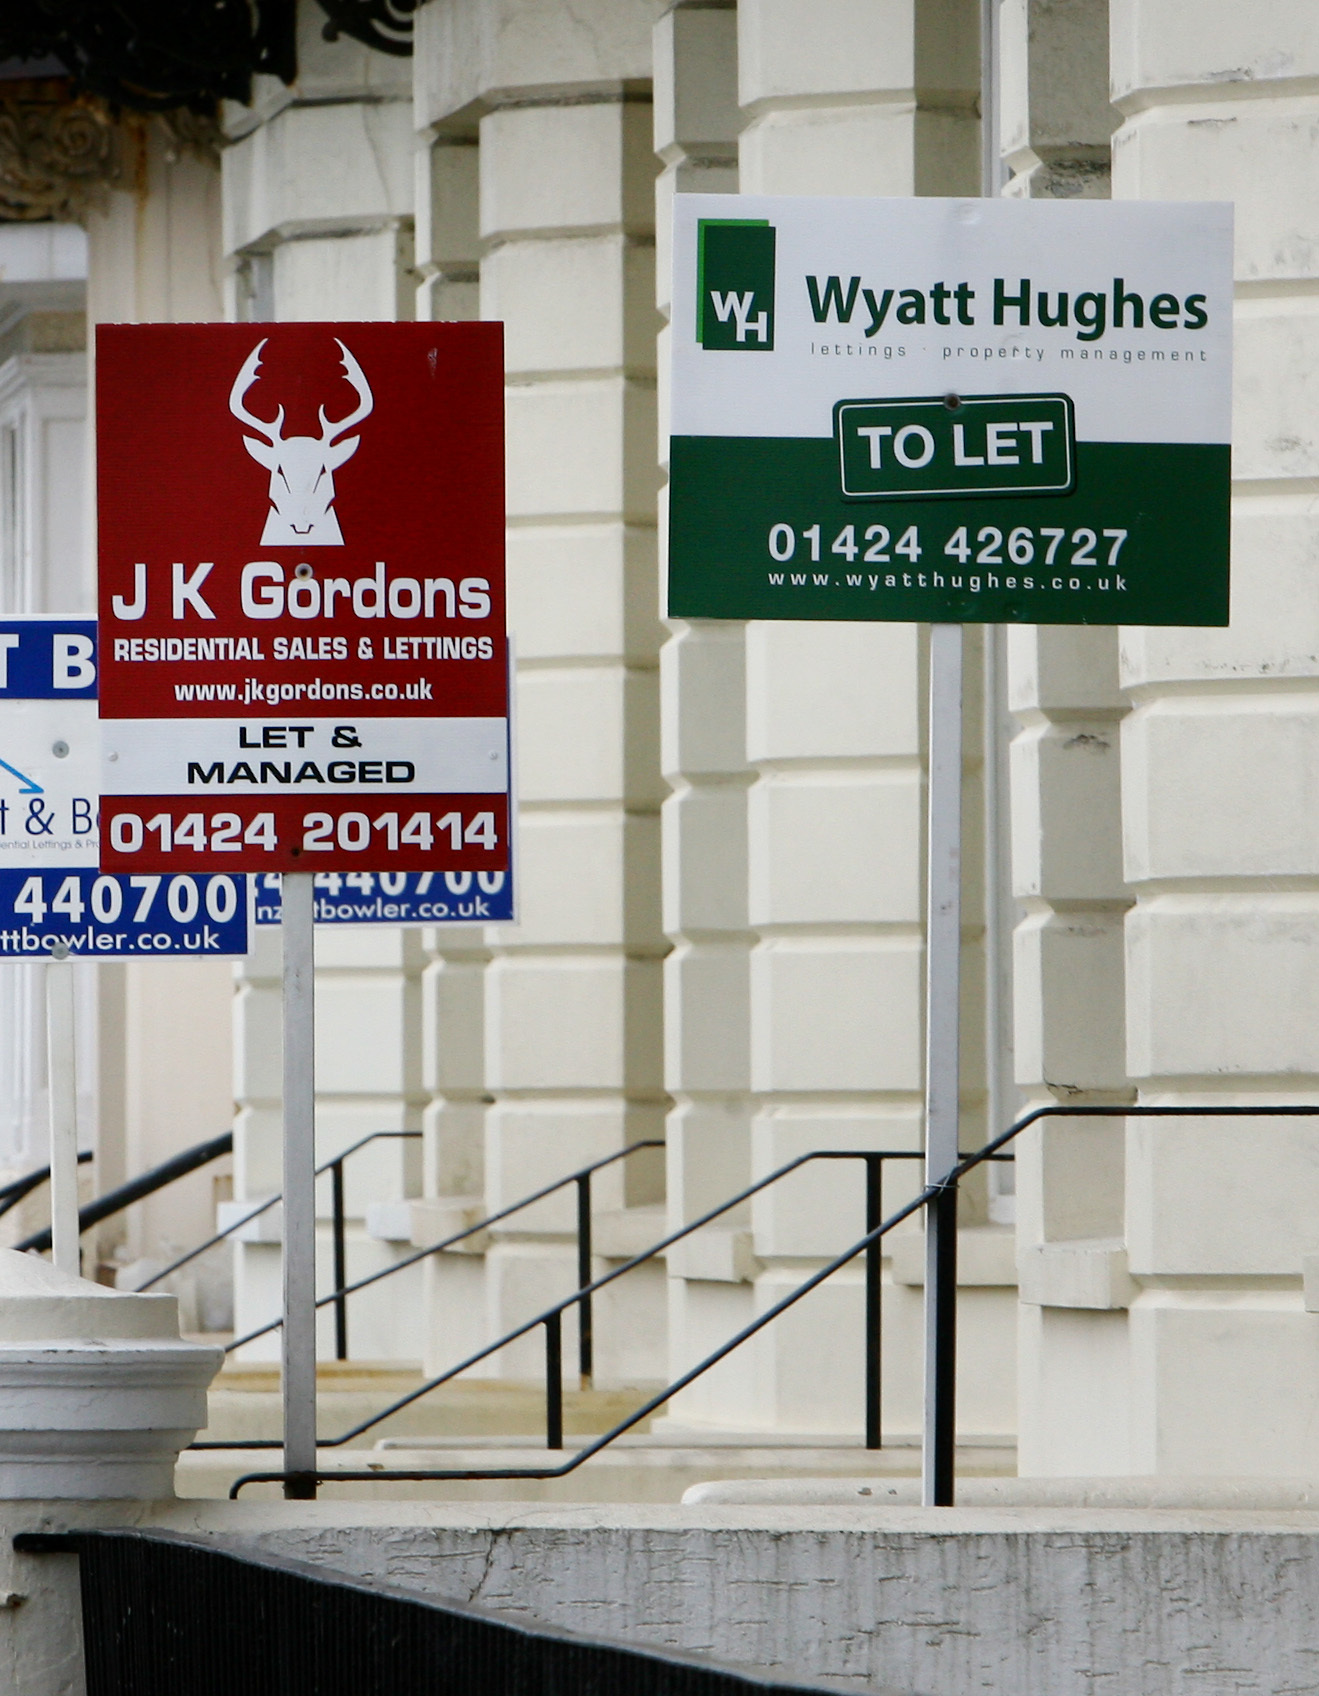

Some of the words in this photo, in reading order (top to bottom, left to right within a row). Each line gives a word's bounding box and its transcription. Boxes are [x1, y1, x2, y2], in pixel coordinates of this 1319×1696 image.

[710, 291, 767, 342] WH
[805, 275, 975, 338] Wyatt
[993, 278, 1208, 341] Hughes
[811, 342, 906, 360] lettings
[943, 345, 1044, 362] property
[1061, 348, 1207, 364] management
[857, 424, 935, 469] TO
[952, 421, 1054, 466] LET
[768, 523, 922, 563] 01424
[944, 526, 1128, 566] 426727
[112, 563, 147, 621] J
[171, 562, 217, 620] K
[241, 561, 491, 620] Gordons
[768, 571, 1128, 592] www.wyatthughes.co.uk
[114, 638, 265, 662] RESIDENTIAL
[273, 637, 348, 661] SALES
[357, 637, 374, 660] &
[383, 636, 494, 660] LETTINGS
[174, 678, 434, 705] www.jkgordons.co.uk
[238, 726, 315, 749] LET
[331, 725, 363, 749] &
[187, 761, 416, 785] MANAGED
[25, 797, 55, 836] &
[72, 798, 100, 836] B
[109, 812, 278, 853] 01424
[302, 811, 498, 851] 201414
[32, 839, 73, 852] Lettings
[75, 839, 83, 849] &
[13, 874, 239, 925] 440700
